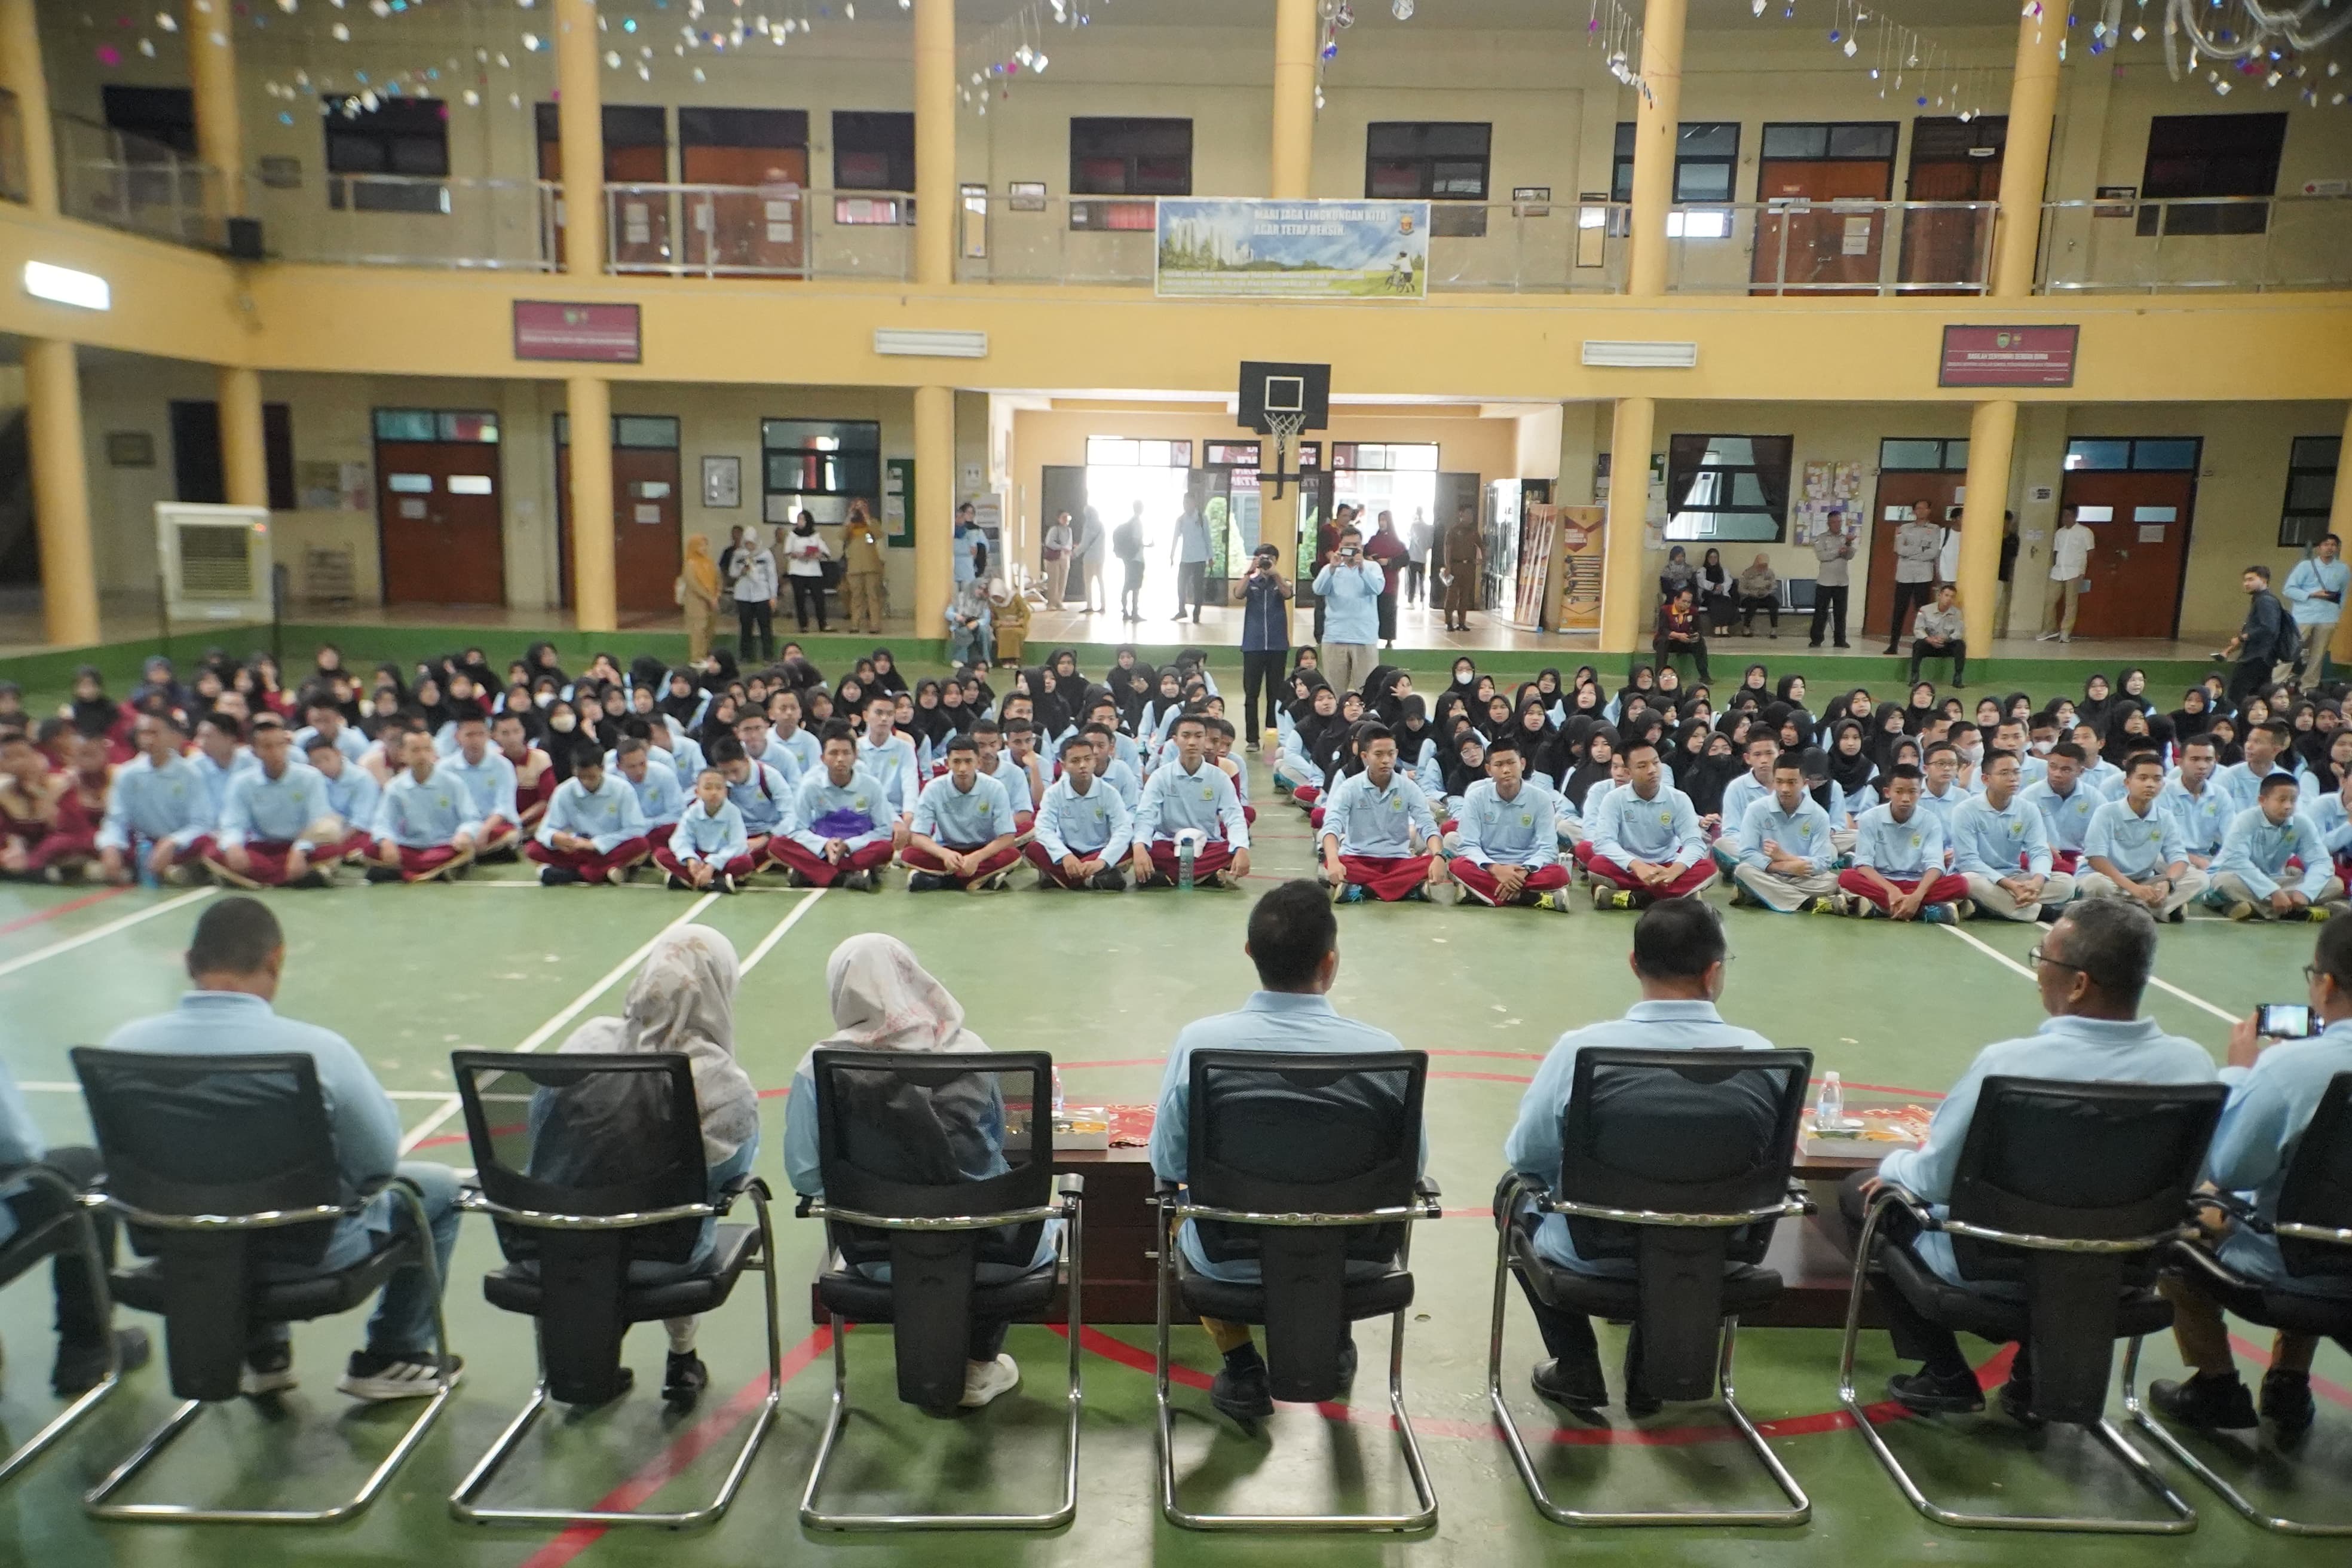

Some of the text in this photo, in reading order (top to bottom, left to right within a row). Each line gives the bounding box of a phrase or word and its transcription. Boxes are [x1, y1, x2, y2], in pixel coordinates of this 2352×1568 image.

[1304, 209, 1364, 222] LINGKUNGAN
[1254, 224, 1279, 235] AGAR
[1281, 224, 1308, 235] TETAP
